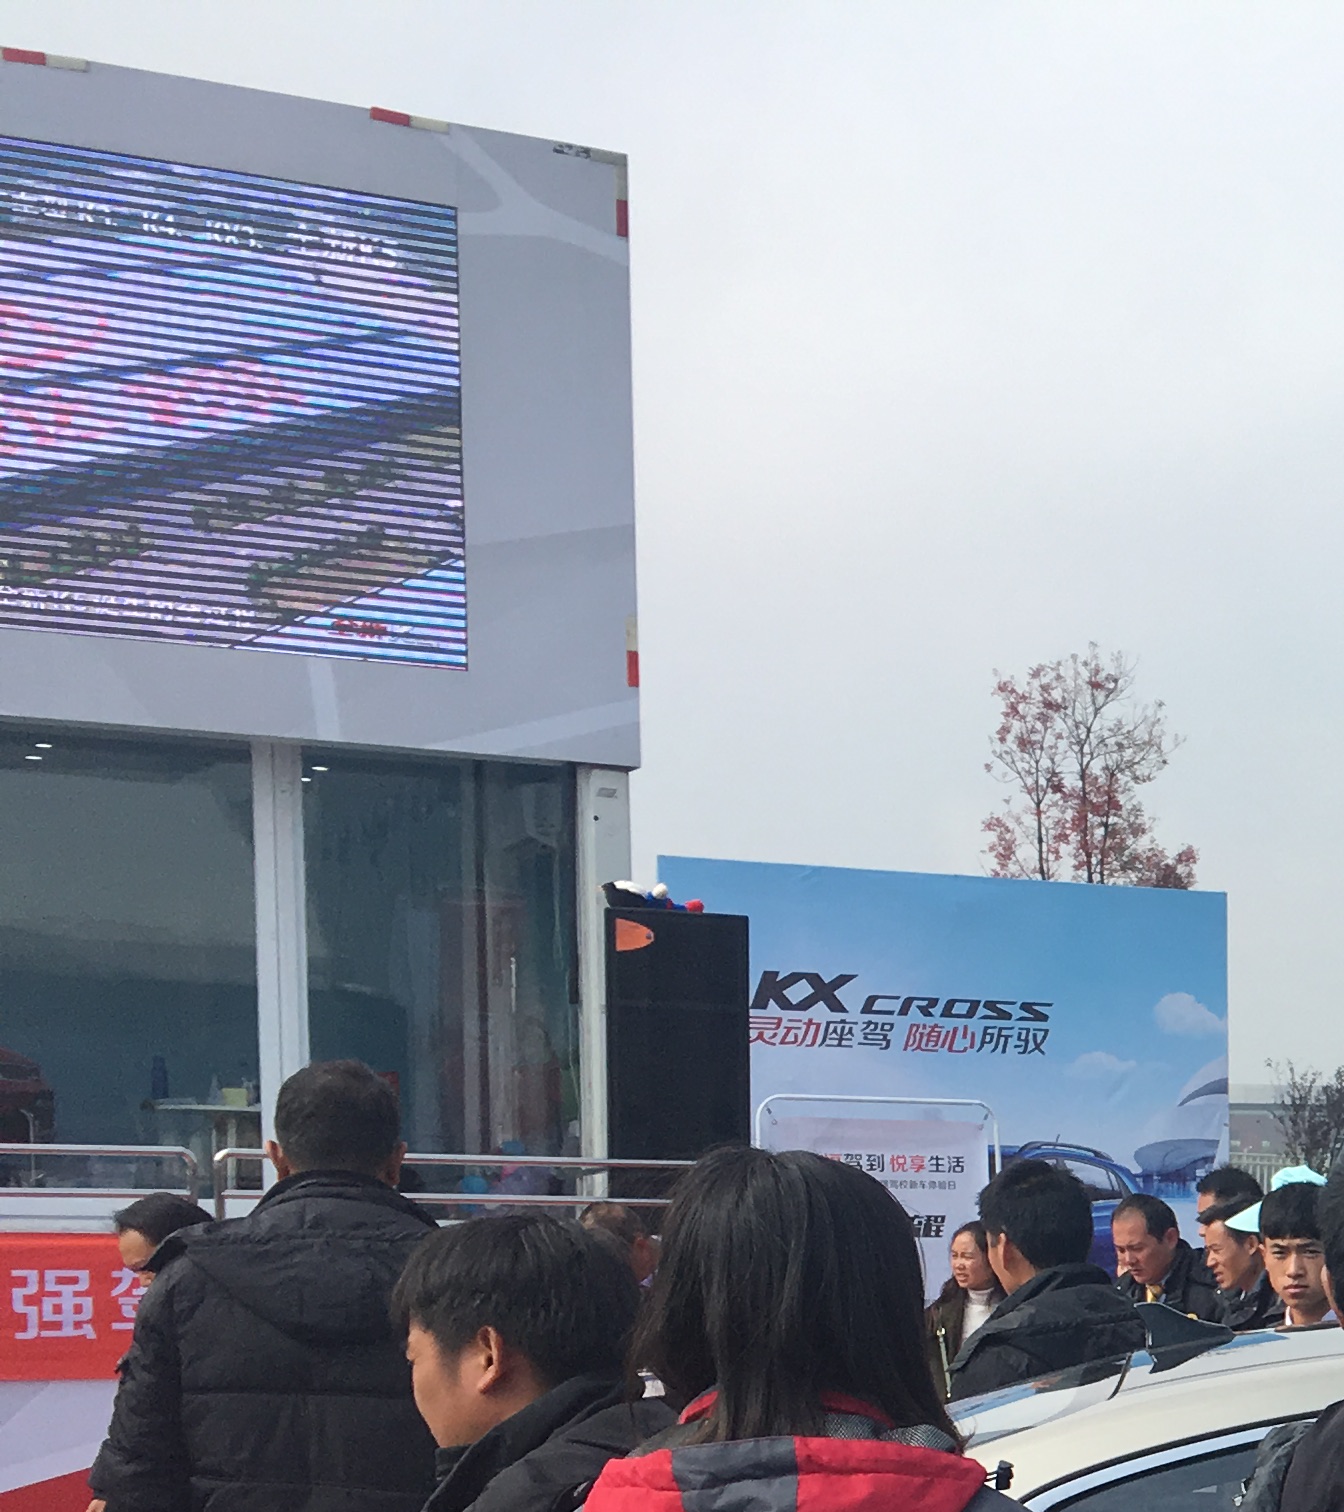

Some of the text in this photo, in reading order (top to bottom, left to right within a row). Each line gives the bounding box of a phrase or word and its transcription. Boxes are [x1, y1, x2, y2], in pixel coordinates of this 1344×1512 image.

[750, 970, 1054, 1023] KX CROSS
[903, 1023, 1050, 1056] 随心所驭
[889, 1154, 965, 1174] 悦享生活
